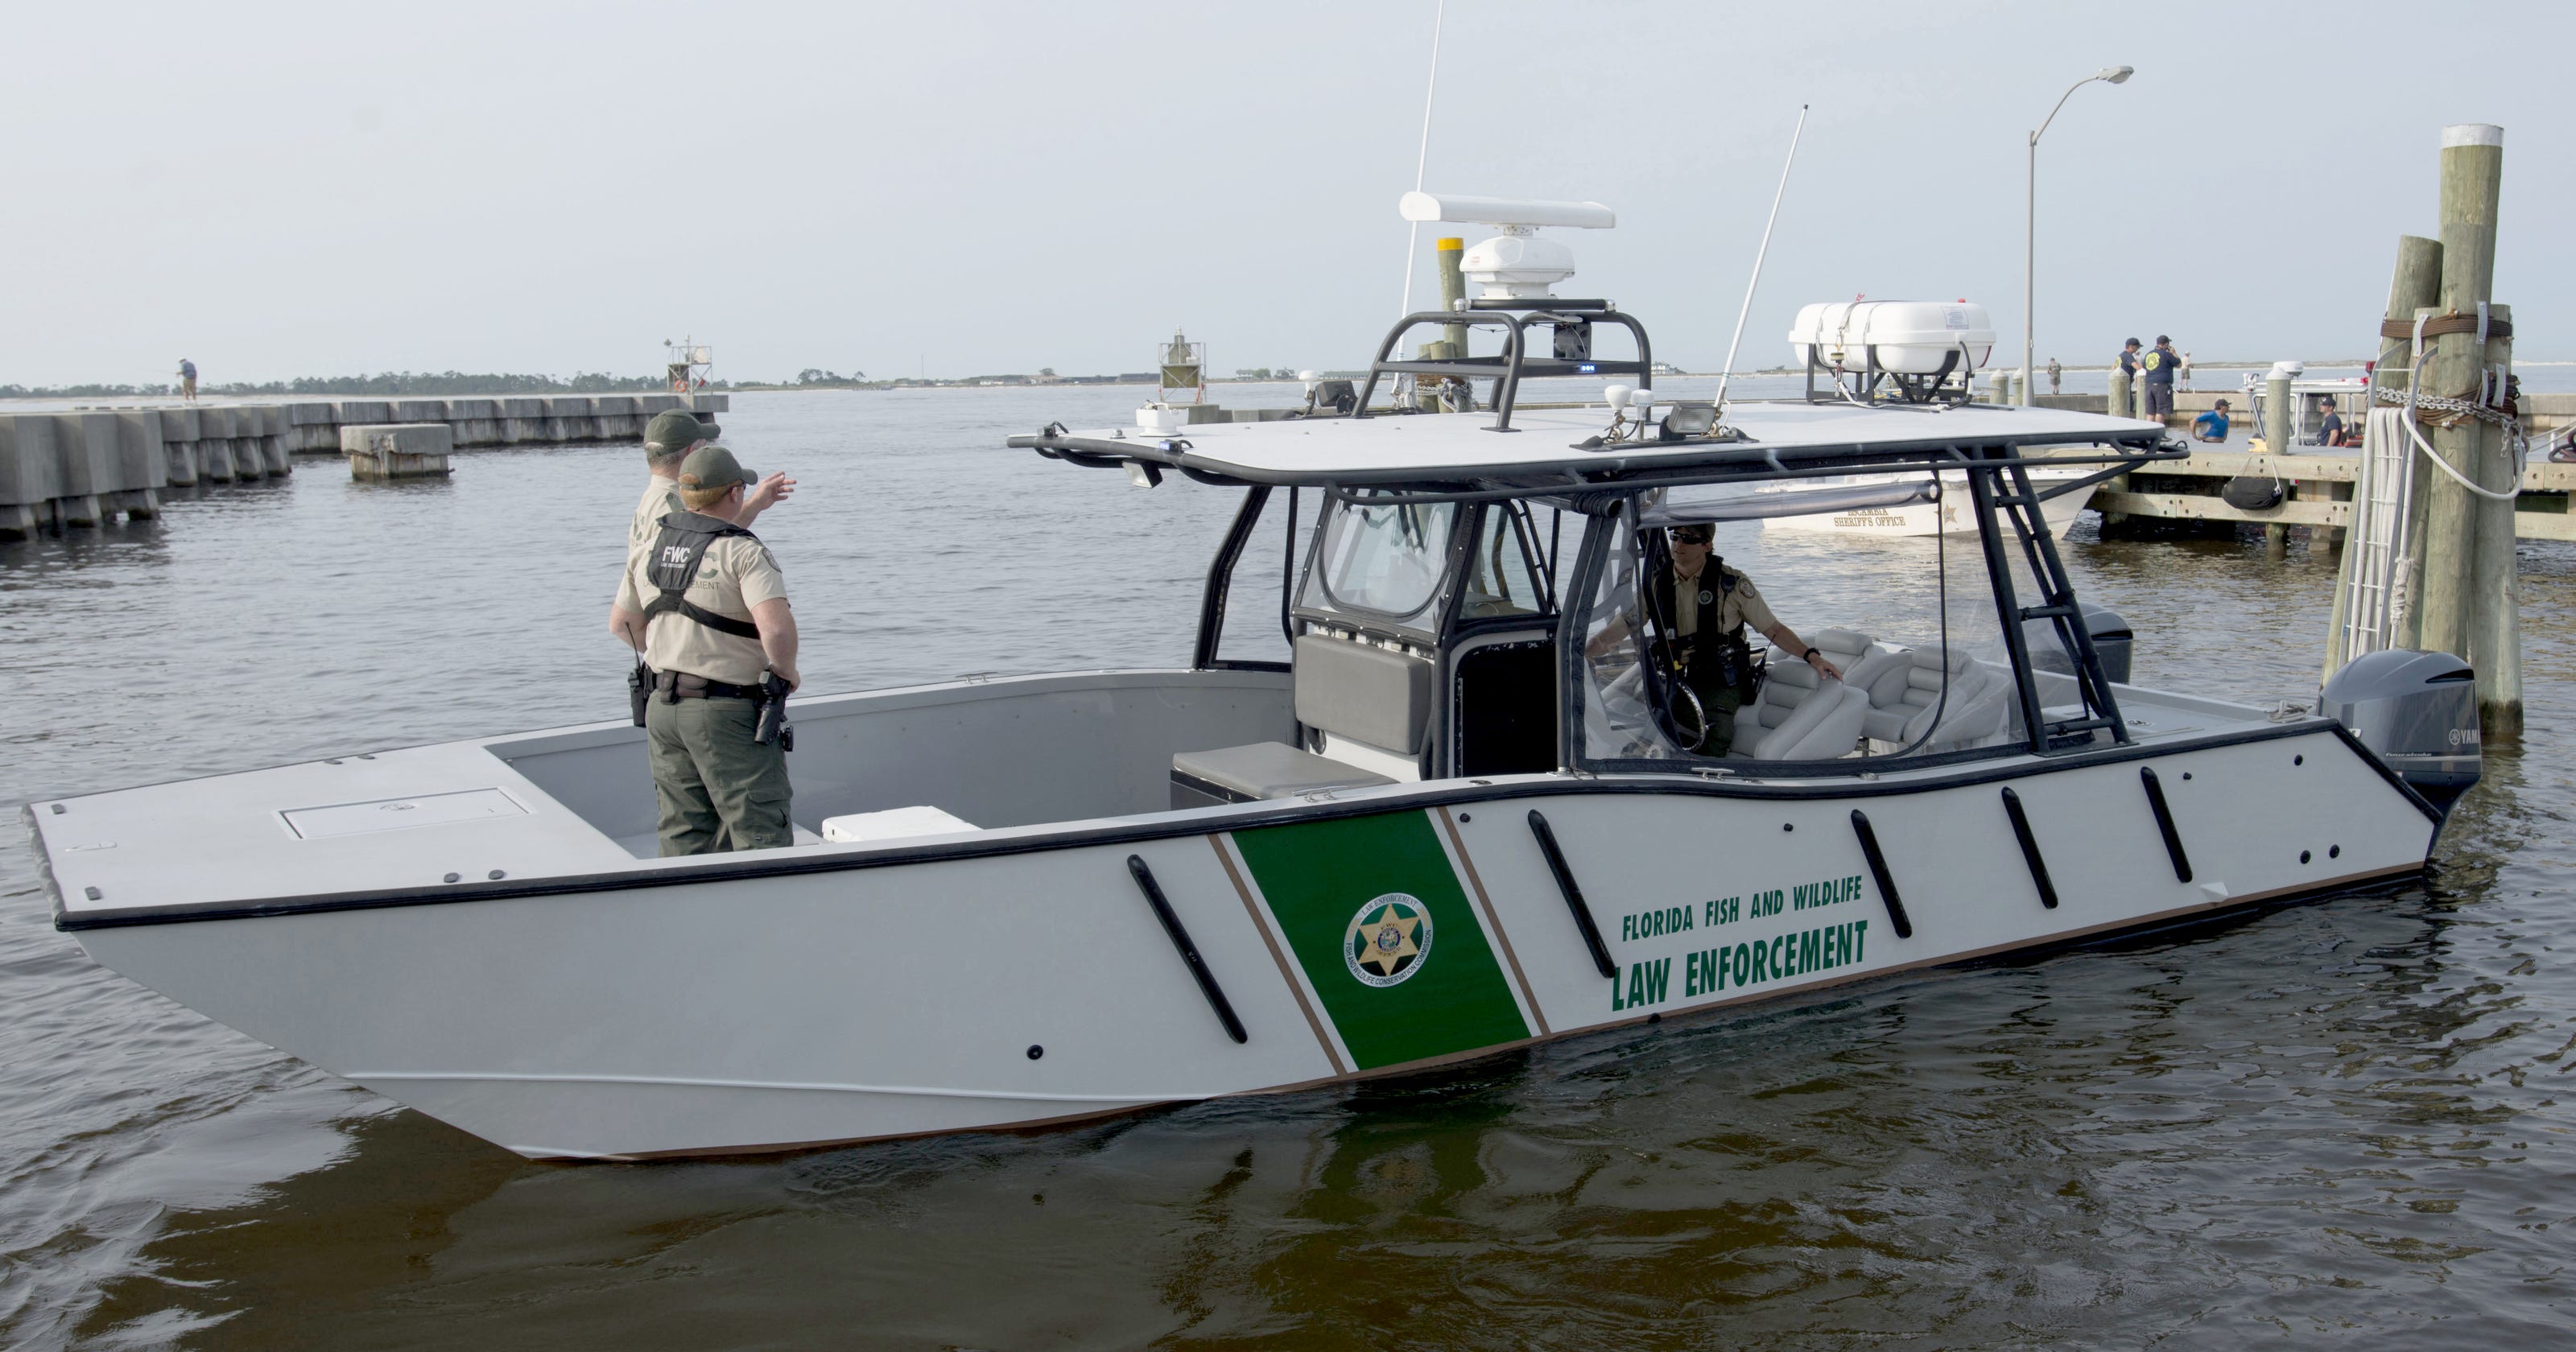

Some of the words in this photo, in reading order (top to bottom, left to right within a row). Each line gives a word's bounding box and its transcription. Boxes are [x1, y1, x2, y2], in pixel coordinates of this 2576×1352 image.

[1875, 516, 1906, 526] OFFICE
[663, 546, 691, 563] FWC
[2460, 729, 2480, 744] YAM
[1361, 903, 1374, 915] LAW
[1374, 894, 1418, 908] ENFORCEMENT
[1622, 905, 1694, 942] FLORIDA
[1705, 897, 1740, 927] FISH
[1750, 889, 1784, 919] AND
[1793, 875, 1862, 911] WILDLIFE
[1345, 942, 1353, 957] FISH
[1353, 966, 1375, 984] WILDLIFE
[1375, 966, 1416, 985] CONSERVATION
[1414, 929, 1432, 966] COMMISSION
[1612, 957, 1671, 1012] LAW
[1685, 919, 1868, 998] ENFORCEMENT
